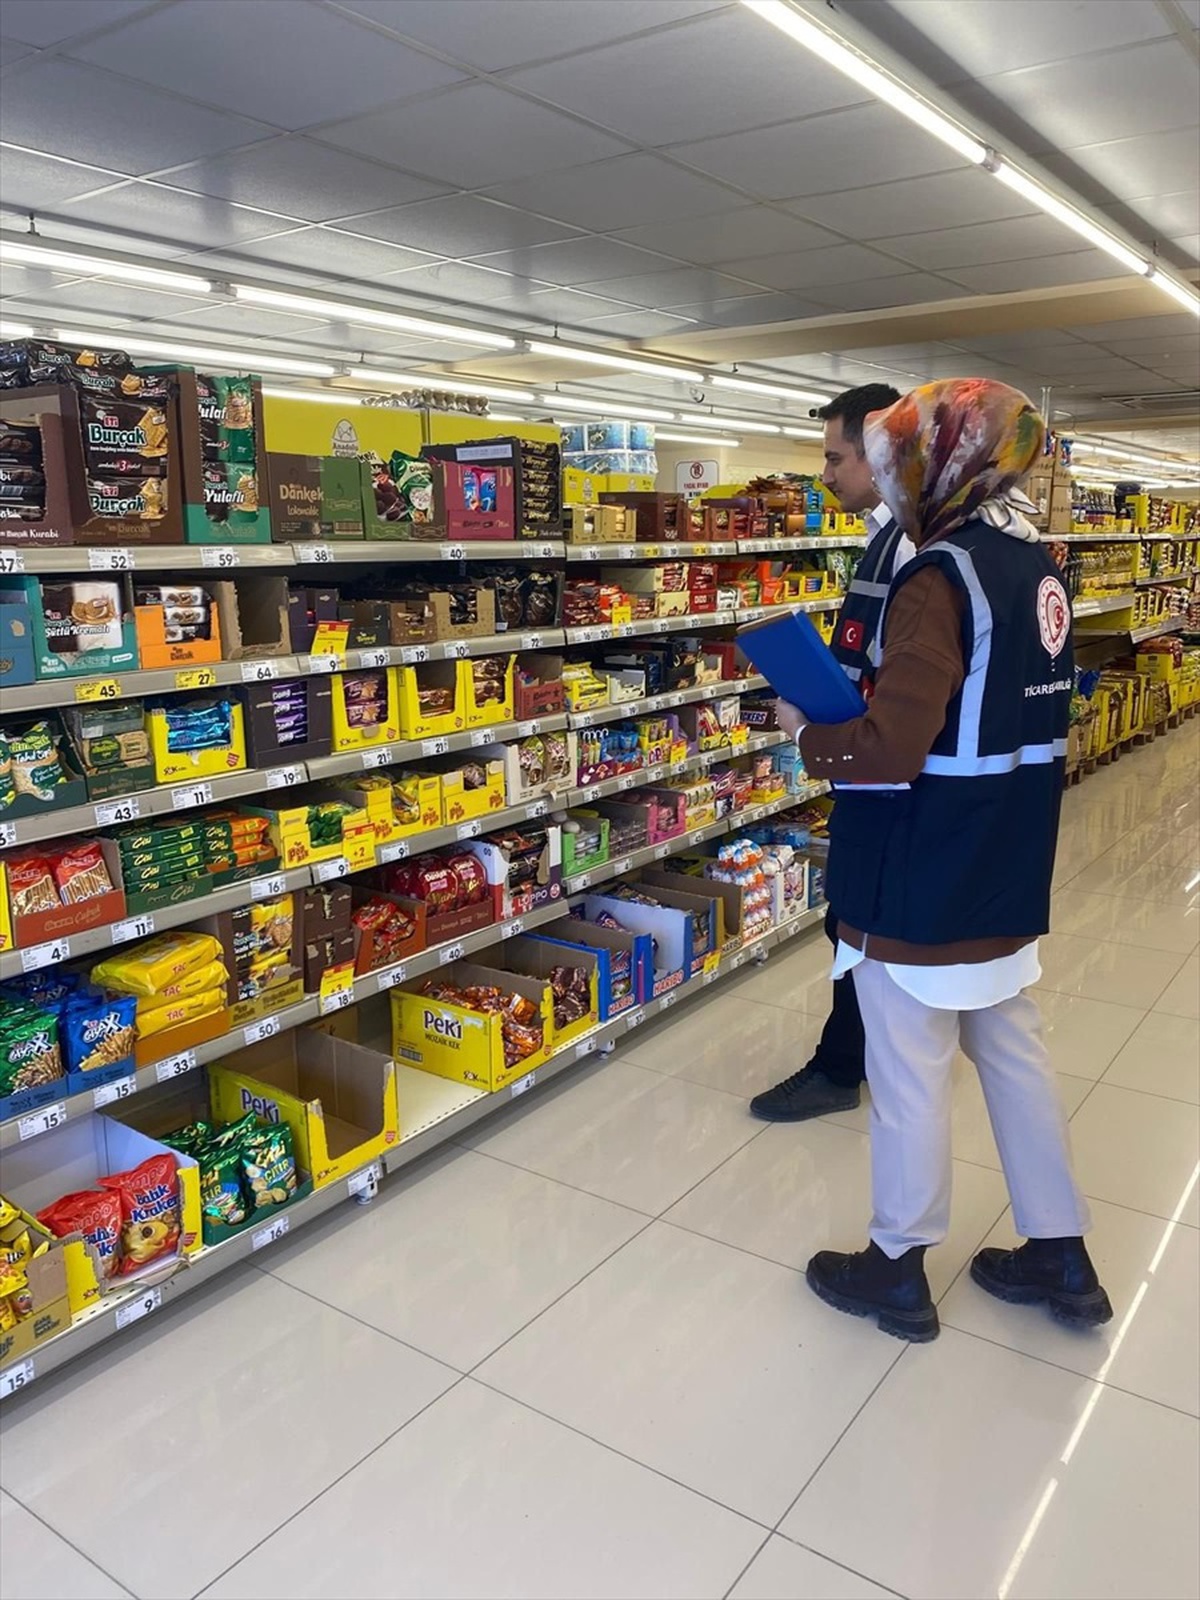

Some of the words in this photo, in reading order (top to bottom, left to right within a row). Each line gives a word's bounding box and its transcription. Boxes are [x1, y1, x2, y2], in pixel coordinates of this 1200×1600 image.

[89, 423, 148, 448] Burçak
[204, 488, 244, 503] Yulaflı
[90, 497, 146, 516] Burçak
[219, 553, 232, 566] 59
[314, 550, 328, 562] 38
[450, 549, 462, 559] 40
[111, 556, 127, 568] 52
[375, 654, 385, 665] 19
[416, 651, 425, 661] 19
[329, 660, 336, 671] 9
[198, 673, 210, 685] 27
[256, 667, 272, 680] 64
[99, 684, 116, 697] 45
[376, 754, 387, 765] 21
[283, 773, 295, 785] 19
[193, 791, 205, 804] 11
[114, 807, 131, 821] 43
[398, 848, 405, 858] 9
[338, 865, 345, 875] 9
[267, 882, 280, 893] 16
[134, 924, 146, 936] 11
[51, 947, 61, 960] 4
[449, 948, 460, 959] 40
[391, 973, 401, 984] 15
[653, 969, 684, 997] HARIBO
[338, 994, 349, 1006] 18
[258, 1023, 273, 1038] 50
[173, 1059, 188, 1074] 33
[115, 1083, 129, 1098] 15
[43, 1113, 58, 1129] 15
[136, 1184, 171, 1206] Balık
[270, 1226, 283, 1240] 16
[144, 1299, 153, 1312] 9
[7, 1372, 25, 1391] 15
